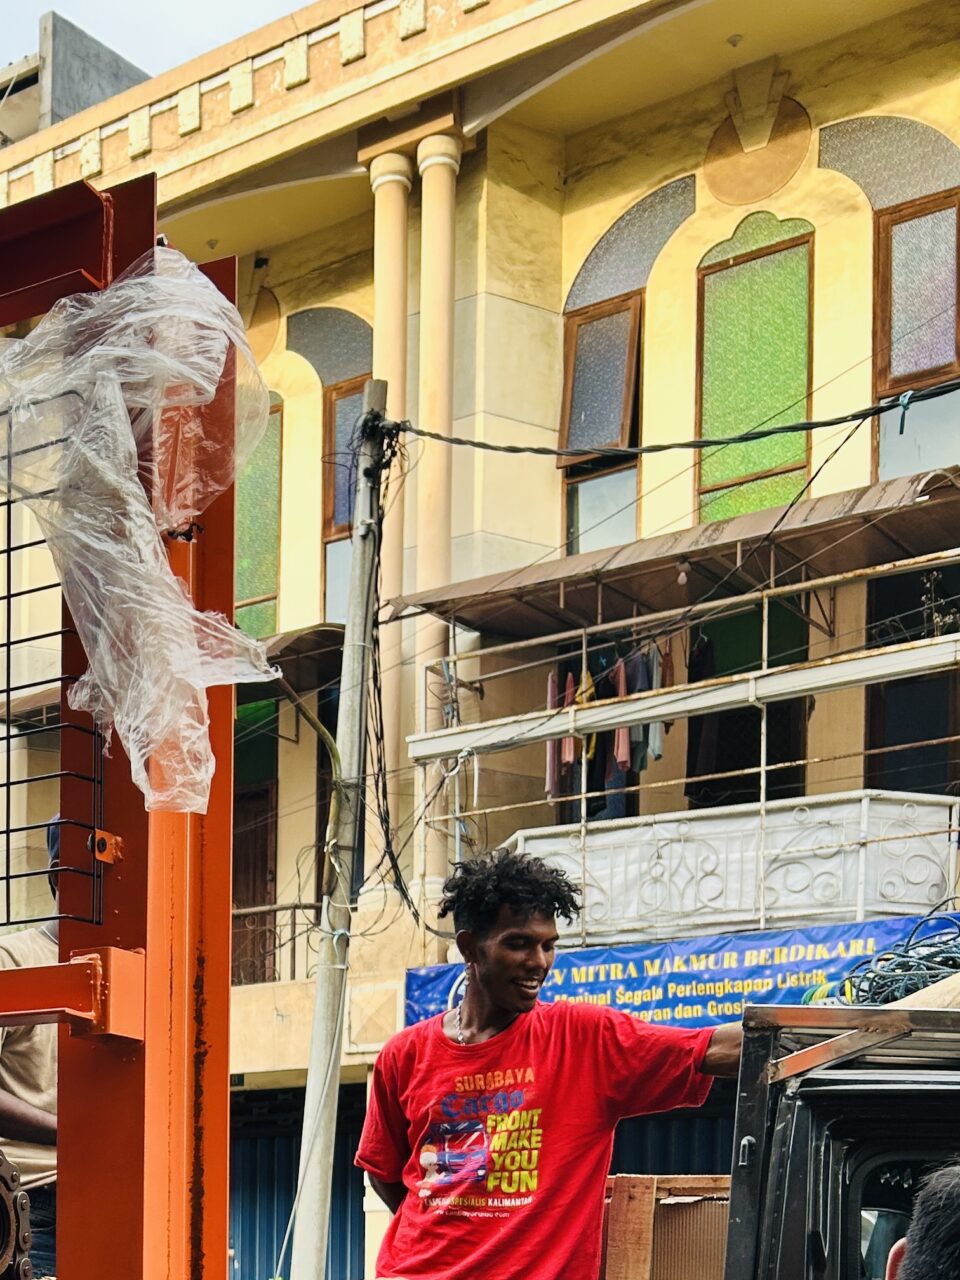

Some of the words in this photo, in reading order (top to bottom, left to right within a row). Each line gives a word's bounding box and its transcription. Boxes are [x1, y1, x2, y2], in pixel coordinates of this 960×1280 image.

[571, 961, 638, 984] MITRA
[643, 951, 738, 977] MAKMUR
[743, 937, 877, 968] BERDIKARI
[616, 985, 663, 1006] Segala
[777, 969, 827, 989] Listrik
[674, 1003, 702, 1020] dan
[455, 1067, 535, 1093] SURABAYA
[441, 1088, 524, 1119] Cargo
[486, 1108, 542, 1133] FRONT
[489, 1129, 543, 1152] MAKE
[491, 1150, 538, 1171] YOU
[487, 1170, 538, 1193] FUN
